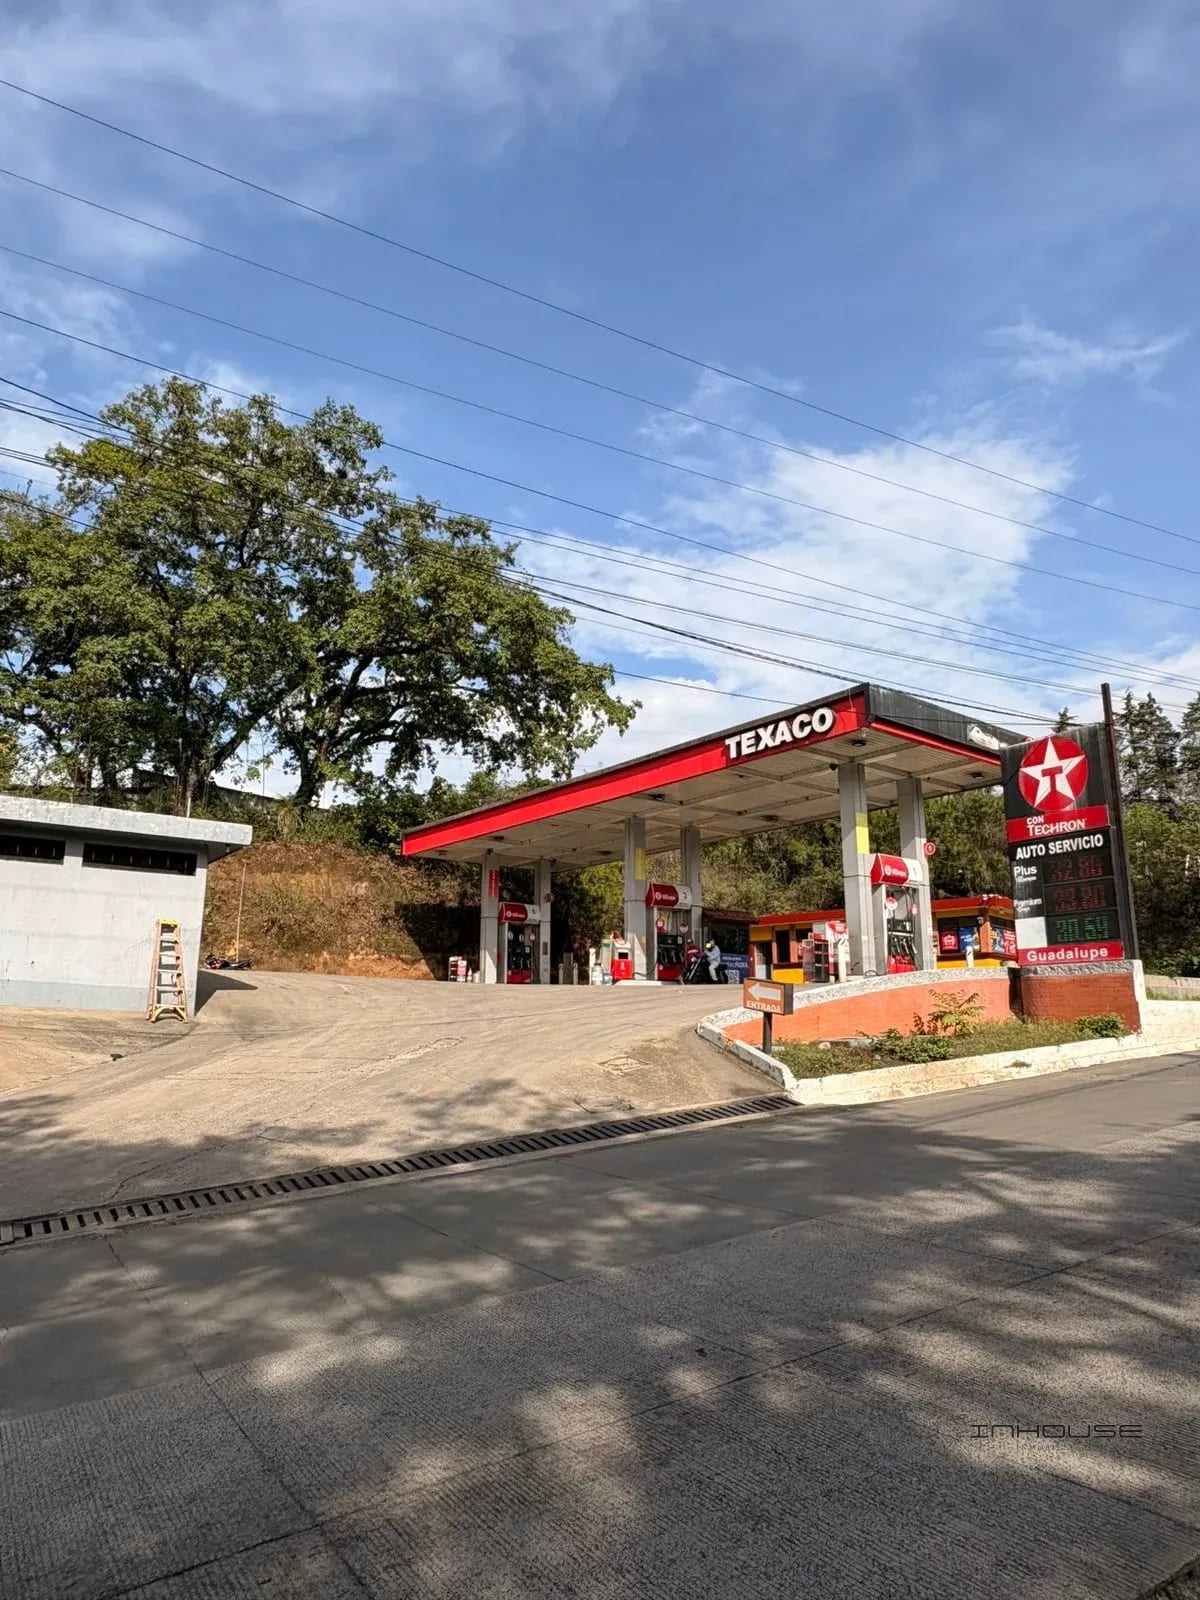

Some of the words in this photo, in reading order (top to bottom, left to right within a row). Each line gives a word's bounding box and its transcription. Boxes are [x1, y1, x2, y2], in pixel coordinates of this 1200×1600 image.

[725, 707, 834, 759] TEXACO
[1041, 766, 1063, 792] T
[1026, 816, 1044, 826] CON
[1027, 818, 1086, 837] TECHRON
[1016, 844, 1046, 860] AUTO
[1048, 834, 1104, 855] SERVICIO
[1013, 865, 1037, 877] Plus
[1027, 946, 1108, 962] Guadalupe
[746, 1000, 782, 1013] ENTRADA
